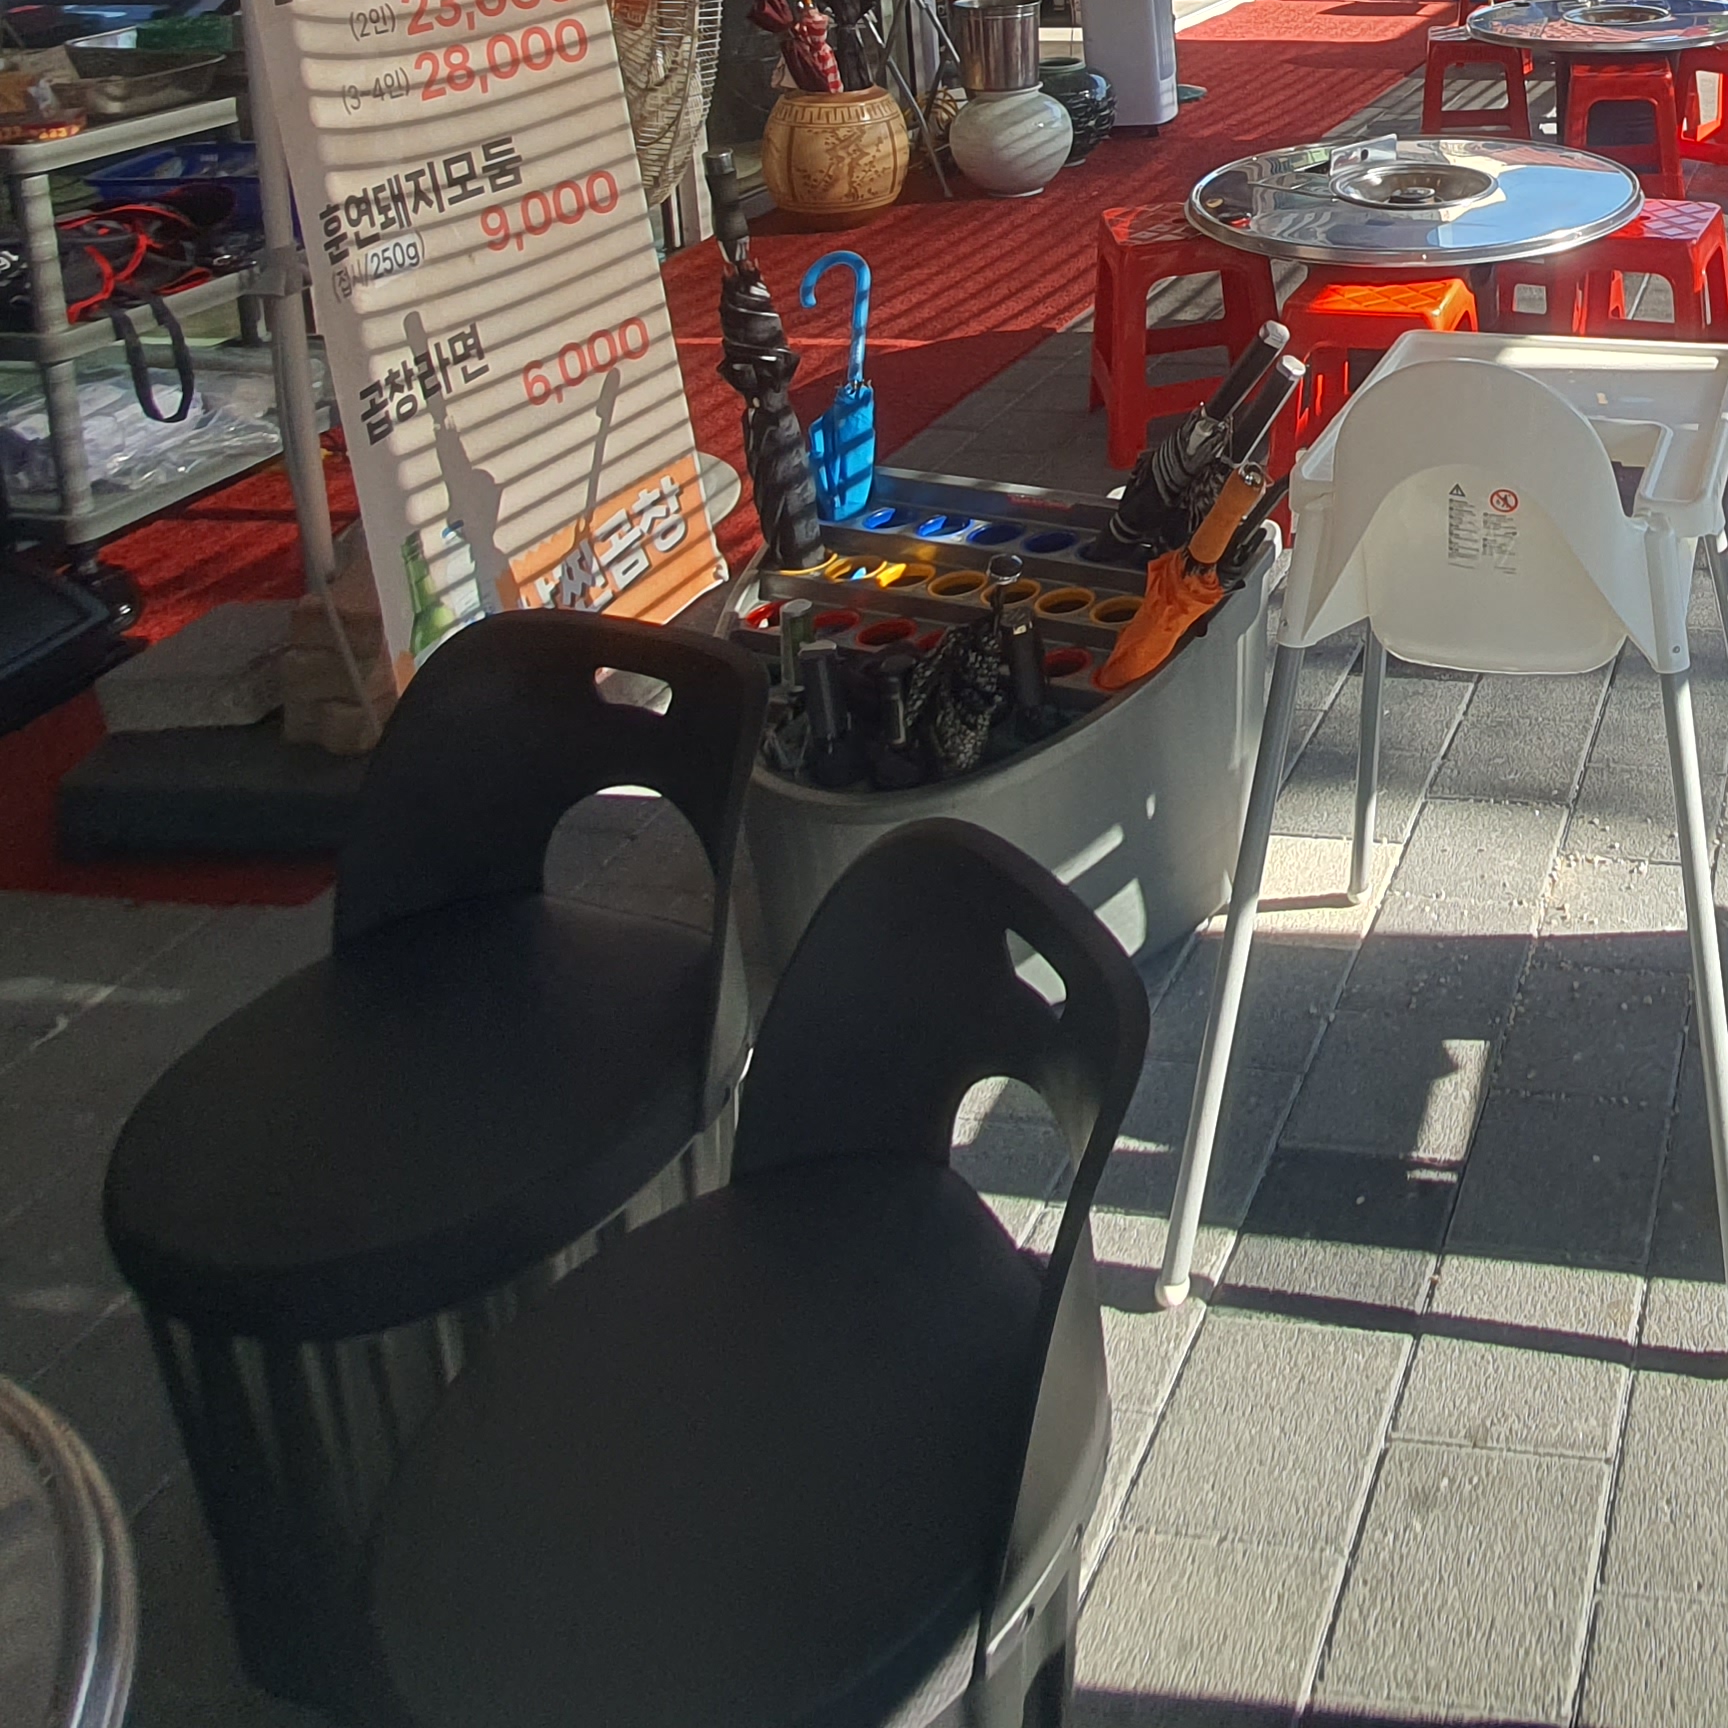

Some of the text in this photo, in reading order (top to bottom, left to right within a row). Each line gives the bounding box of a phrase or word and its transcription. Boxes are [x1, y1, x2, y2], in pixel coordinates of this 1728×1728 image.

[341, 17, 590, 117] (3-4인) 28,000
[348, 2, 397, 43] (2인)
[318, 136, 524, 266] 훈연돼지모둠
[478, 169, 621, 254] 9,000
[360, 321, 492, 447] 곱창라면
[520, 314, 652, 407] 6,000
